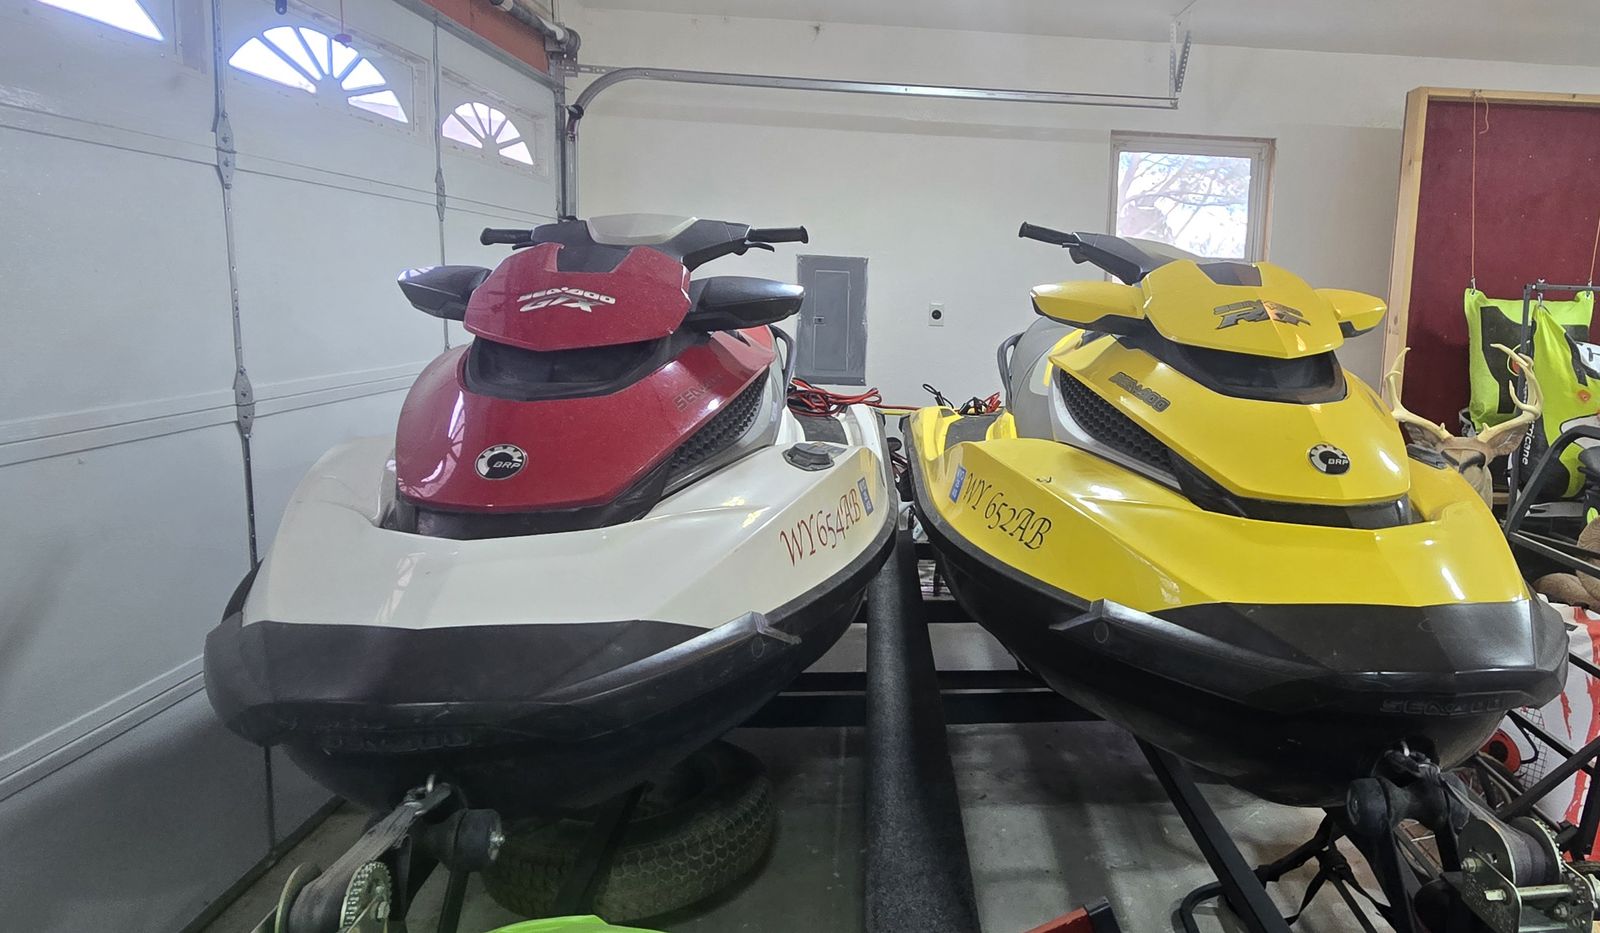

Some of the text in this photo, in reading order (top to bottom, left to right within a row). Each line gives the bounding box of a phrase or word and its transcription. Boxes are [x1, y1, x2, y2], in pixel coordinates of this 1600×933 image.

[779, 513, 816, 567] WY
[816, 488, 861, 549] 654AB
[963, 472, 992, 510] WY
[985, 492, 1052, 550] 652AB
